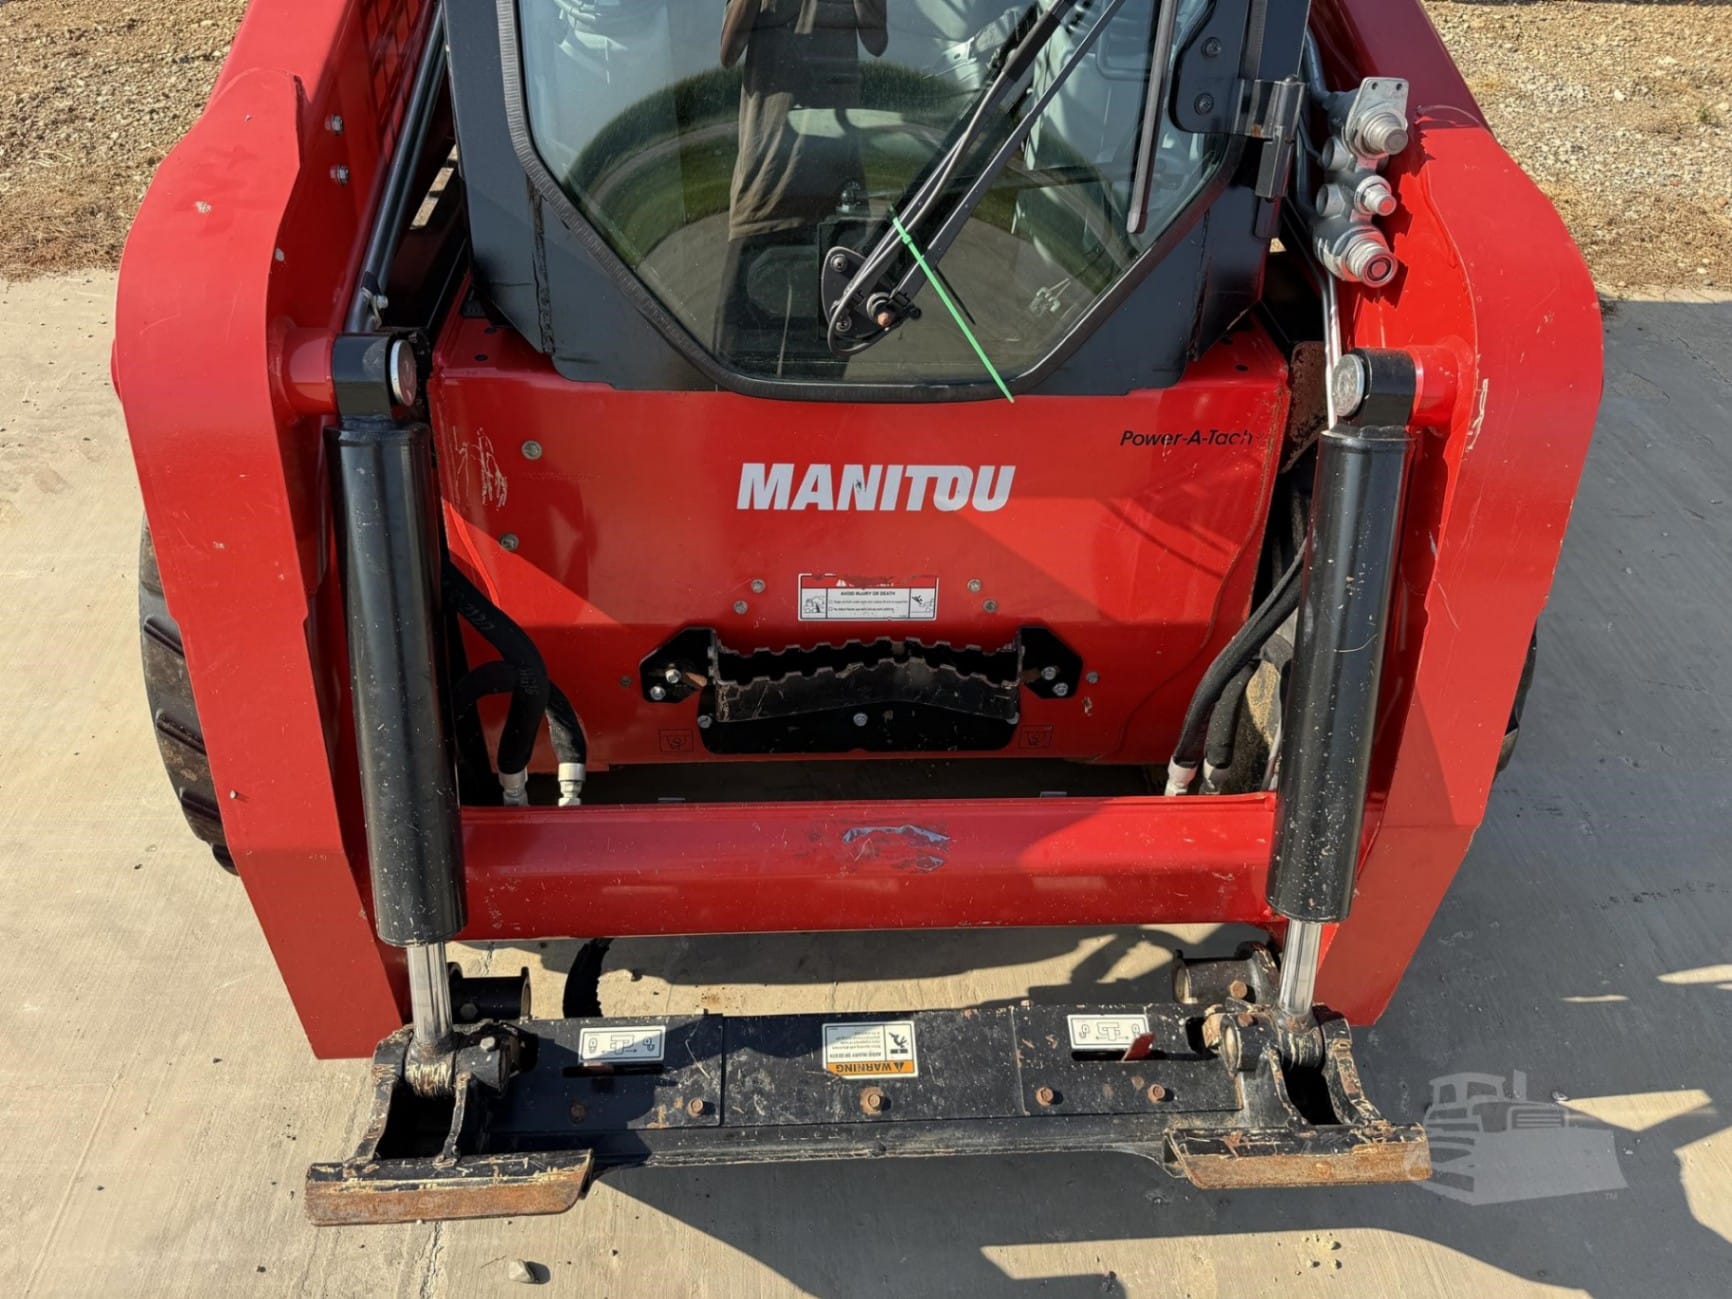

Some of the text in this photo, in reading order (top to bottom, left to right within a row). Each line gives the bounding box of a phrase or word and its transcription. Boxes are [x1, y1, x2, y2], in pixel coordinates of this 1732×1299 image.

[1120, 429, 1253, 446] Power-A-Tach
[736, 463, 1016, 512] MANITOU
[836, 1062, 892, 1073] WARNING
